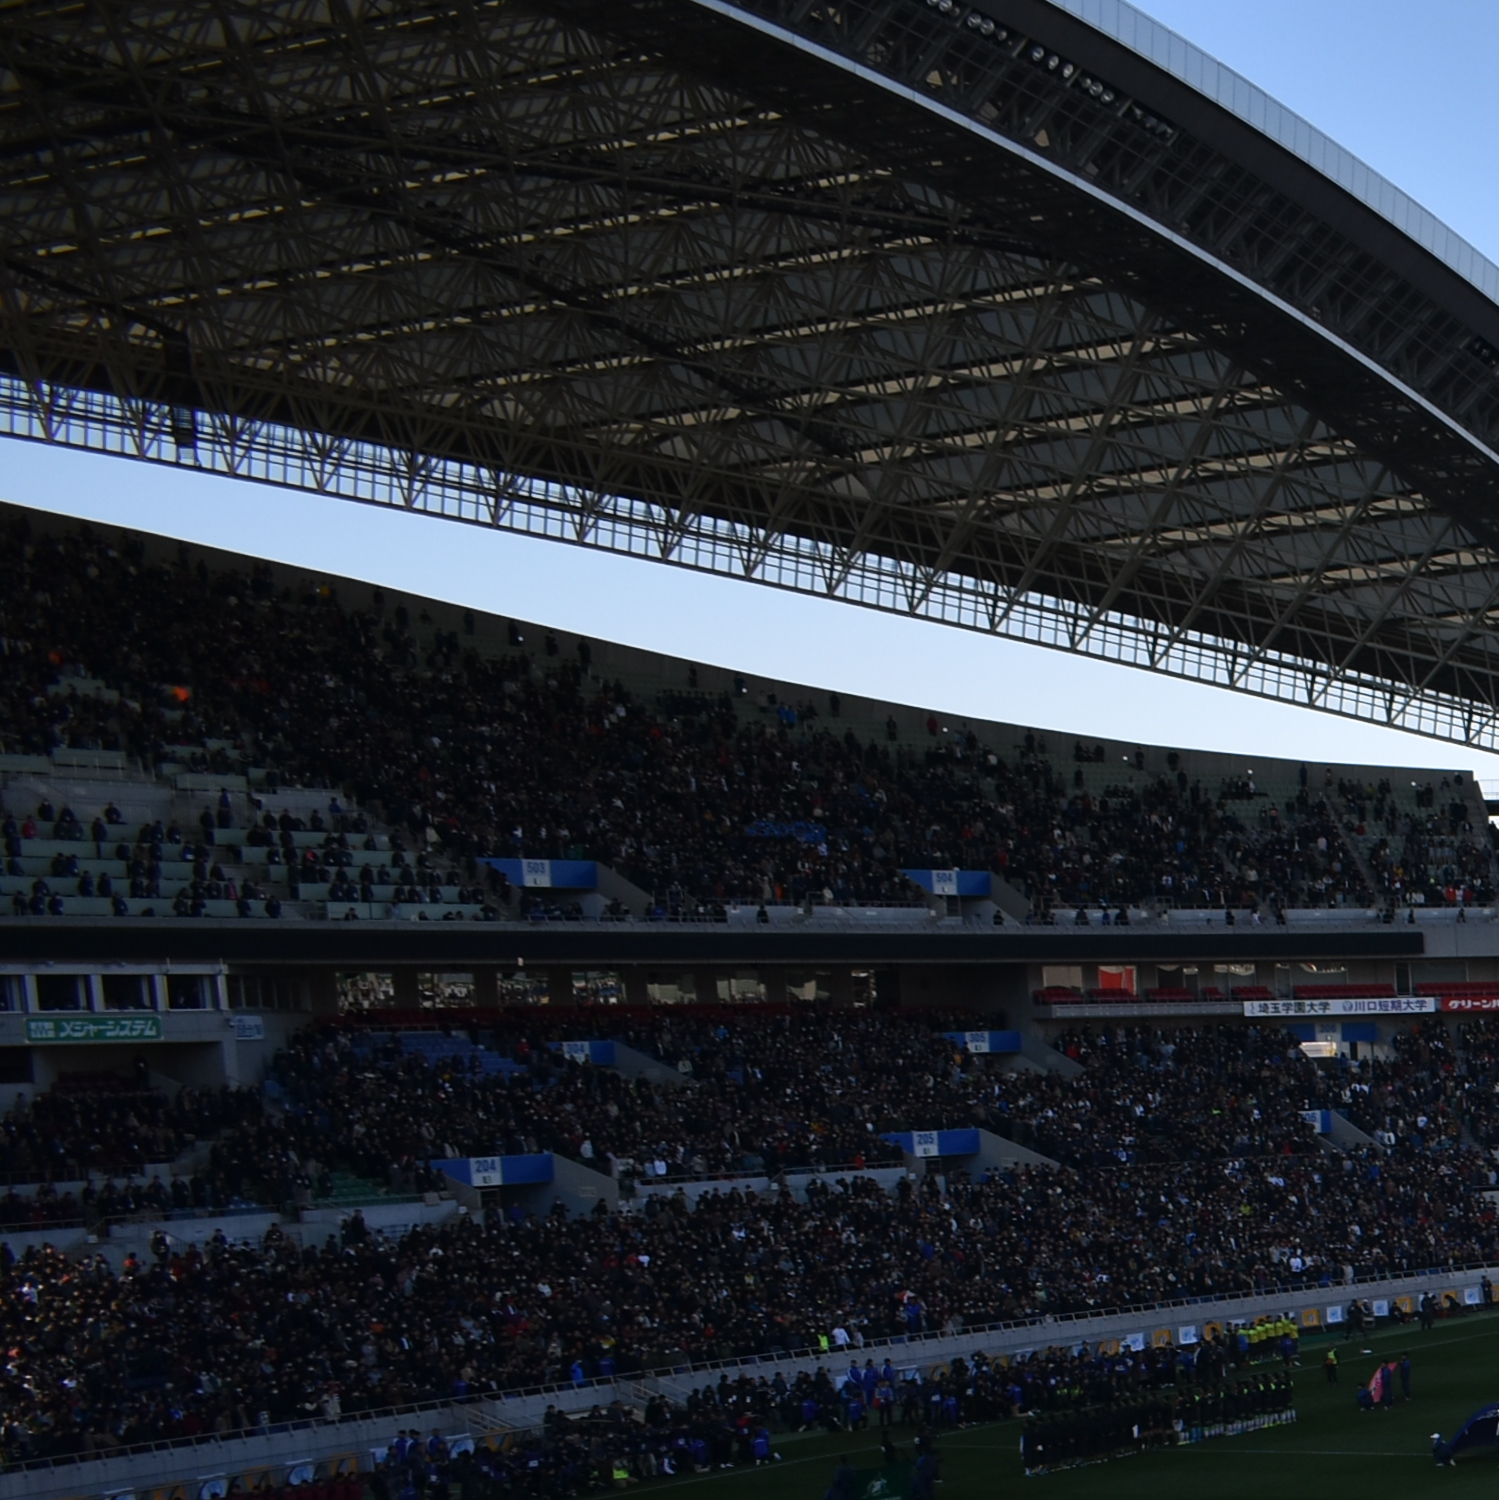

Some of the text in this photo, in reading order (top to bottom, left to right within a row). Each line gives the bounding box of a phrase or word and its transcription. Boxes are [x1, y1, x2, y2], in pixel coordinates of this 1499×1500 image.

[1258, 1001, 1331, 1014] 埼玉学園大学
[1354, 999, 1428, 1012] 川口短期大学
[59, 1020, 157, 1037] メジャーシステム
[917, 1133, 935, 1145] 205
[475, 1160, 496, 1172] 204
